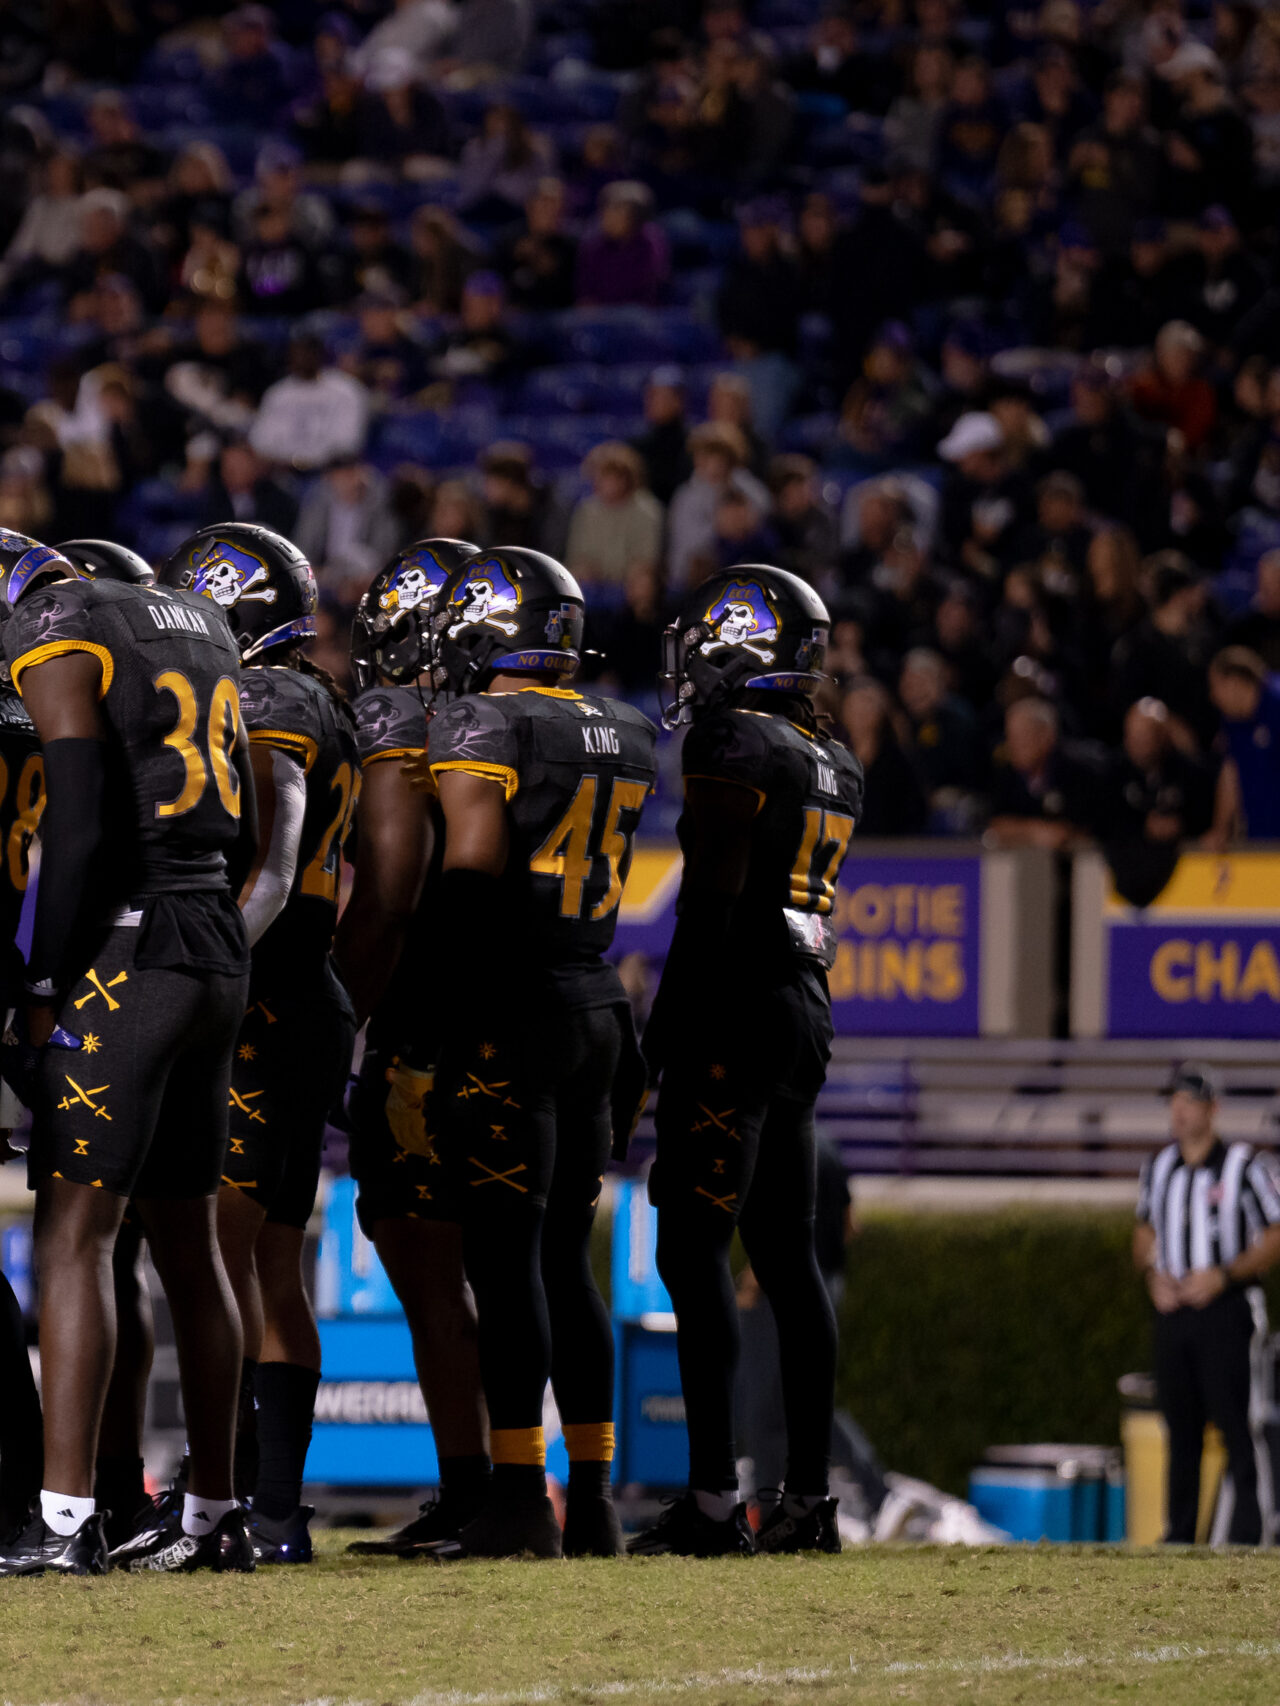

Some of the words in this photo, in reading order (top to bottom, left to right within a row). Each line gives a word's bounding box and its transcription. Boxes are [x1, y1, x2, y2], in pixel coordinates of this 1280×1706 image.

[16, 560, 33, 580] NO
[728, 588, 755, 599] ECU
[517, 654, 540, 667] NO
[772, 677, 794, 689] NO
[151, 668, 242, 820] 30
[582, 726, 620, 755] KING
[817, 762, 839, 797] KING
[297, 759, 364, 904] 2
[528, 773, 650, 921] 45
[788, 804, 856, 914] 17
